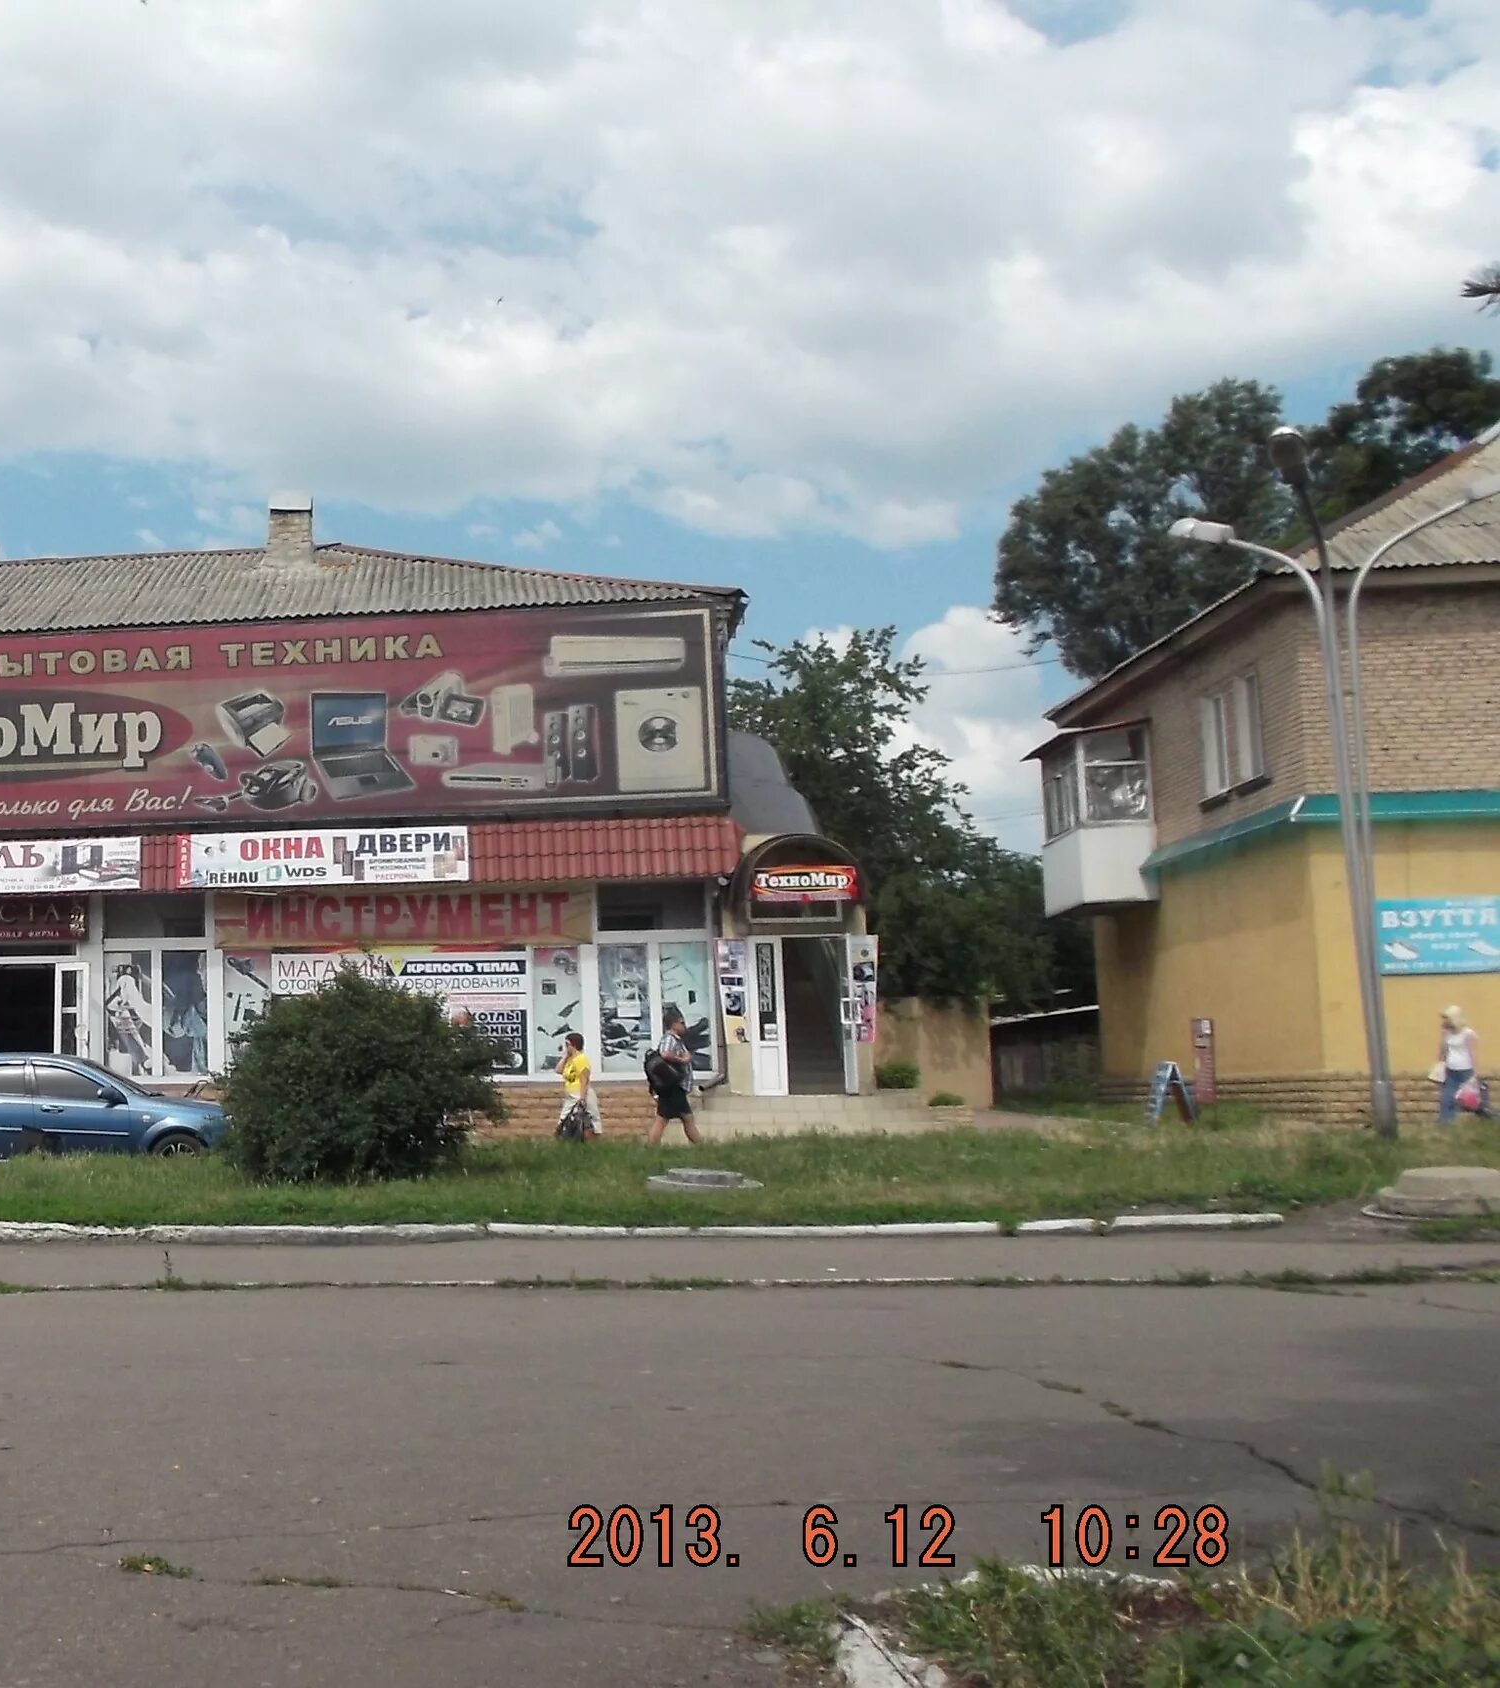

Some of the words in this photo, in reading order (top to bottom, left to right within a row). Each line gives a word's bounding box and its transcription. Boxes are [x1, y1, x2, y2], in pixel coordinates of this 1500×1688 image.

[220, 633, 445, 669] ТЕХНИКА
[327, 716, 373, 727] ASUS
[67, 794, 115, 819] для
[125, 785, 192, 815] Вас!
[239, 836, 325, 862] ОКНА
[356, 832, 451, 858] ДВЕРИ
[209, 869, 259, 884] REHAU
[285, 864, 327, 878] WDS
[756, 872, 849, 890] ТехноМир
[245, 891, 570, 940] ИНСТРУМЕНТ
[1381, 907, 1498, 928] ВЗУТТЯ
[28, 930, 61, 938] ФИРМА
[406, 963, 474, 974] КРЕПОСТЬ
[476, 961, 520, 973] ТЕПЛА
[404, 976, 520, 990] ОБОРУДОВАНИЯ
